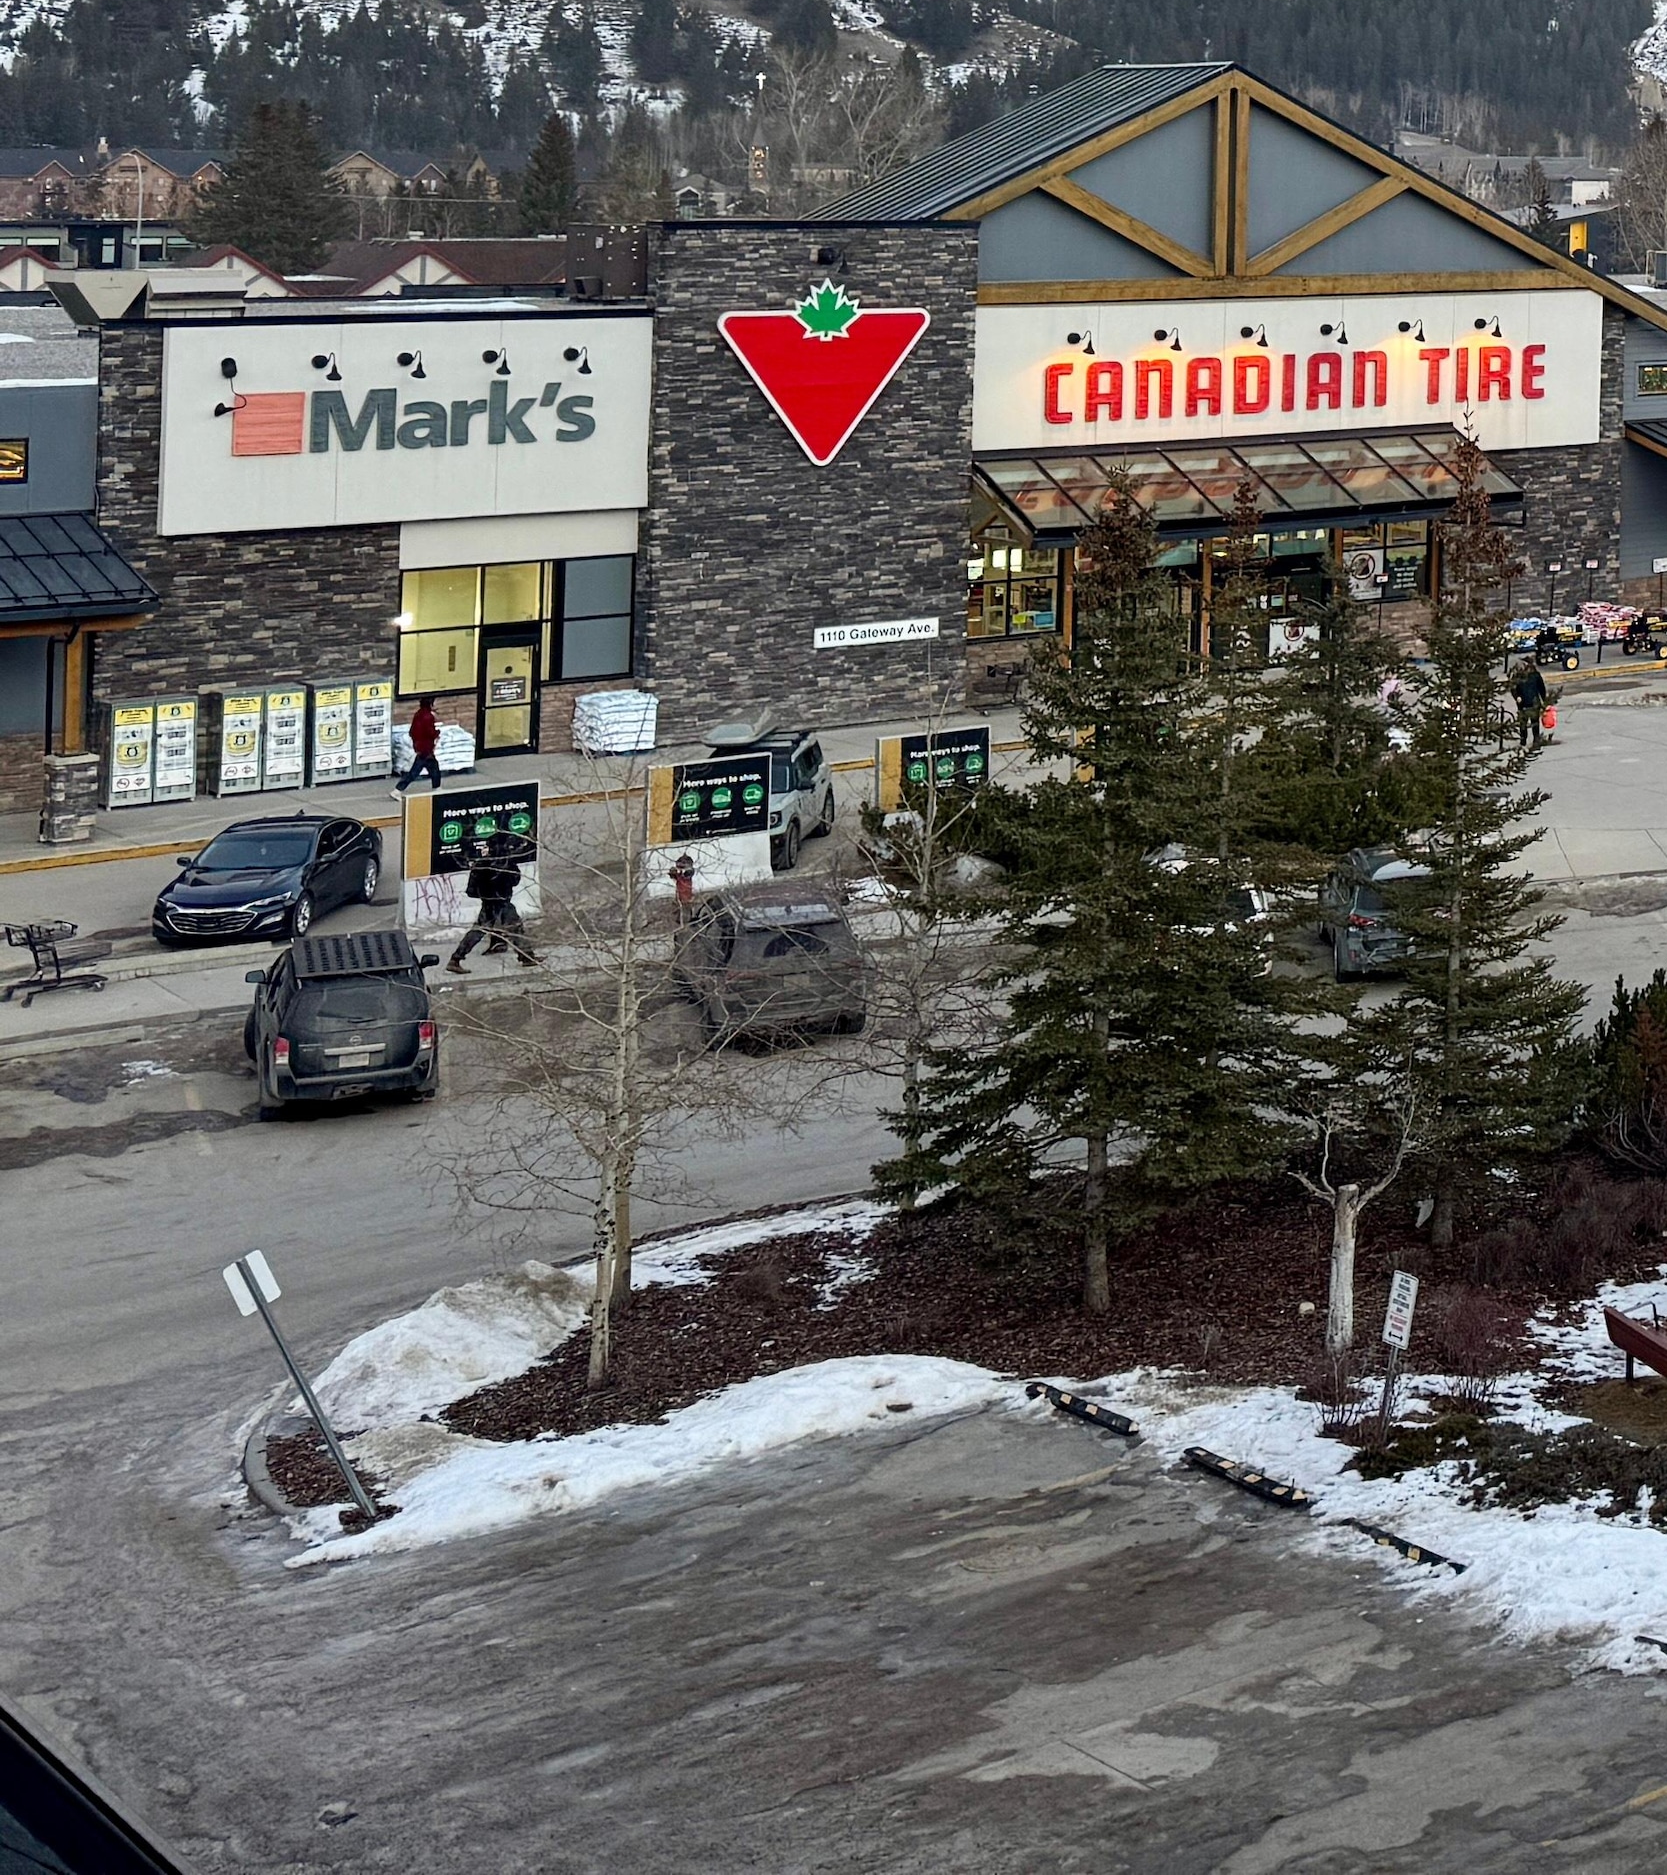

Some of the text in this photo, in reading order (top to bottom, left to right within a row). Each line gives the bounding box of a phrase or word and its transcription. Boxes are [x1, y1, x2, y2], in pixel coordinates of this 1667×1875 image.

[1044, 343, 1546, 424] CANADIAN TIRE
[309, 379, 596, 454] Mark's
[820, 623, 935, 643] 1110 Gateway Ave.
[729, 775, 738, 783] to
[443, 809, 467, 818] More
[468, 806, 491, 814] ways
[492, 804, 503, 812] to
